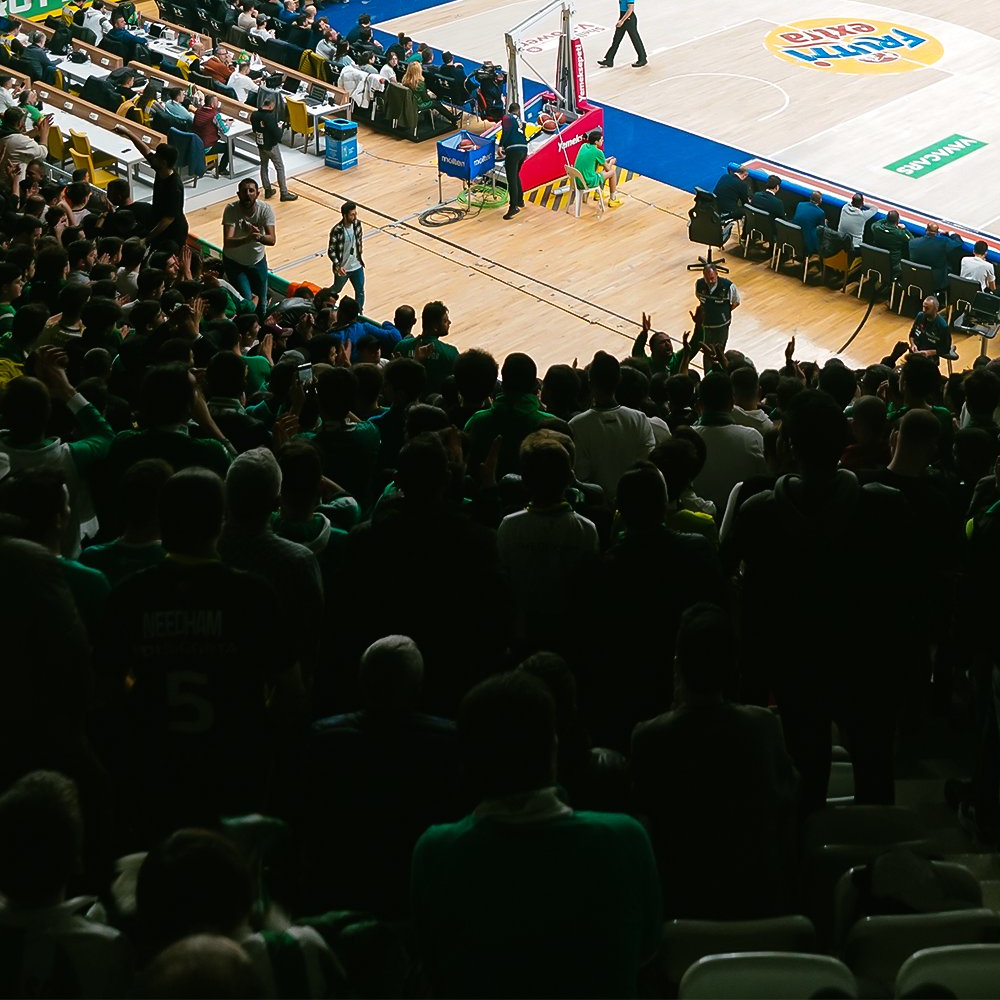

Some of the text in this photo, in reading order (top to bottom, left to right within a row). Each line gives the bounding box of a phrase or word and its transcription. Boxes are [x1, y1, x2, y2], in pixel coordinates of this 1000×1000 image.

[780, 23, 876, 44] extra
[574, 44, 588, 102] Yemeksepeti
[441, 156, 465, 167] molten
[896, 138, 978, 176] VAVACARS
[166, 669, 215, 734] 5
